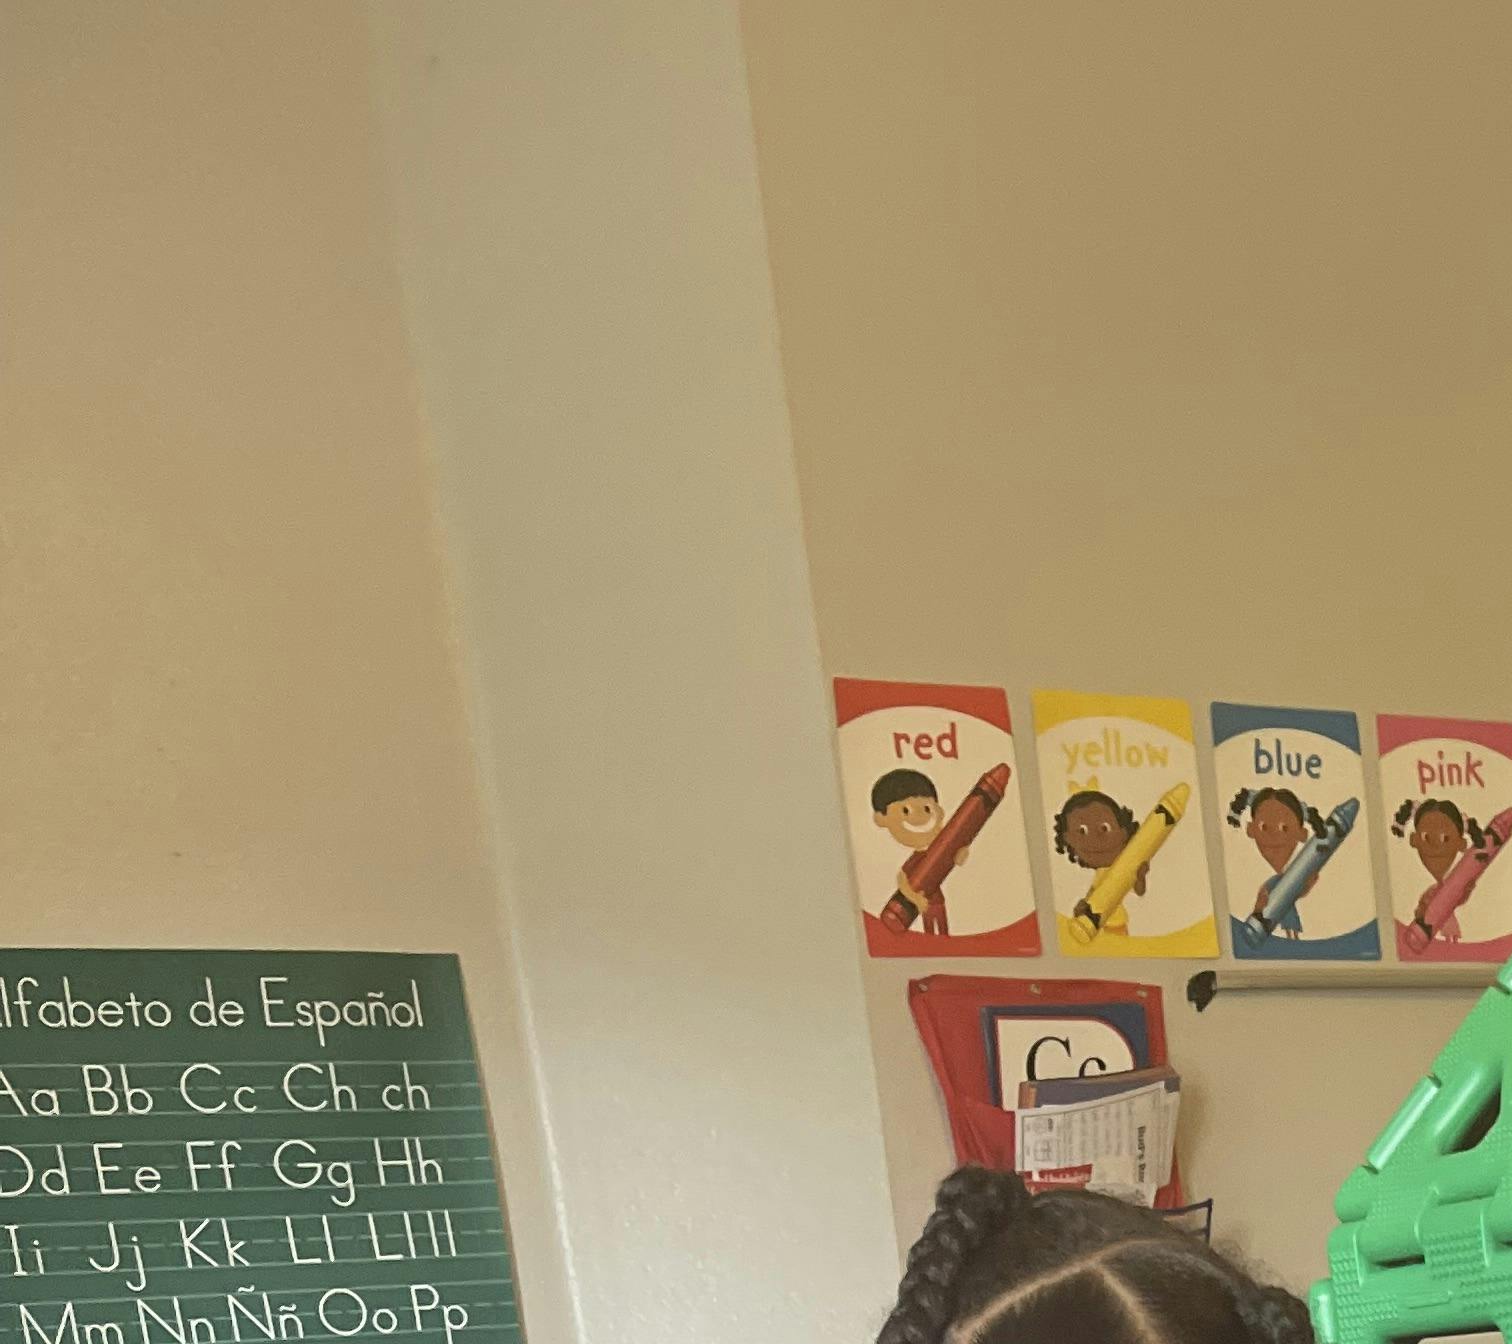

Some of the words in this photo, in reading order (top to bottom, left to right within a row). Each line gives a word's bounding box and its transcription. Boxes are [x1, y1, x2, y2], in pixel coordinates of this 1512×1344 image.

[892, 722, 959, 761] red
[1061, 729, 1171, 774] yellow
[1254, 738, 1323, 780] blue
[1417, 751, 1487, 794] pink
[0, 975, 172, 1029] lfabeto
[189, 978, 245, 1029] de
[260, 976, 425, 1047] Español
[82, 1064, 154, 1117] Bb
[179, 1063, 257, 1115] Cc
[282, 1062, 357, 1112] Ch
[381, 1062, 431, 1112] ch
[93, 1142, 161, 1195] Ee
[184, 1140, 242, 1192] Ff
[273, 1139, 355, 1207] Gg
[373, 1136, 443, 1187] Hh
[3, 1224, 46, 1276] Ii
[89, 1221, 148, 1292] Jj
[179, 1217, 250, 1269] Kk
[286, 1214, 336, 1264] Ll
[228, 1285, 304, 1342] Ññ
[318, 1288, 398, 1336] Oo
